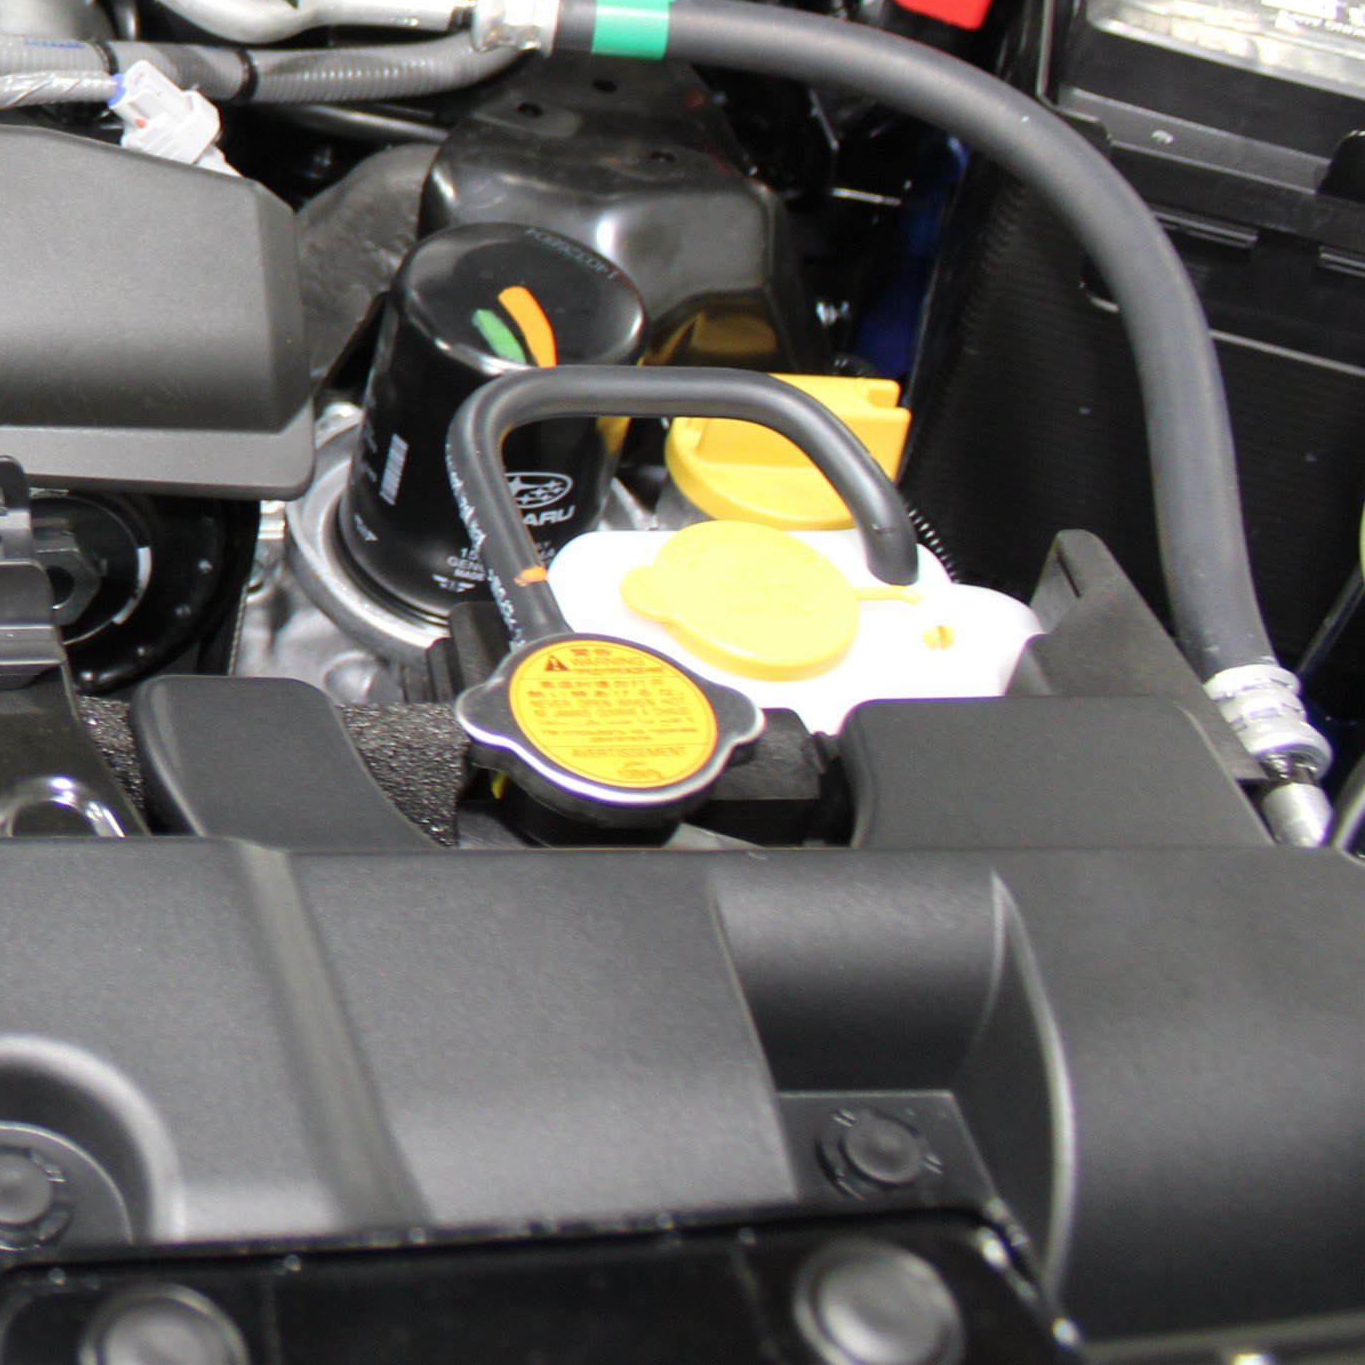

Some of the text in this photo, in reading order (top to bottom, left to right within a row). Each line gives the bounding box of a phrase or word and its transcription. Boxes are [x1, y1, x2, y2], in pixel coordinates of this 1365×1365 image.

[521, 506, 576, 526] ARU
[569, 656, 646, 667] WARNING
[529, 697, 685, 708] NEVER OPEN WHEN HOT
[572, 747, 687, 757] AVERTISSEMENT
